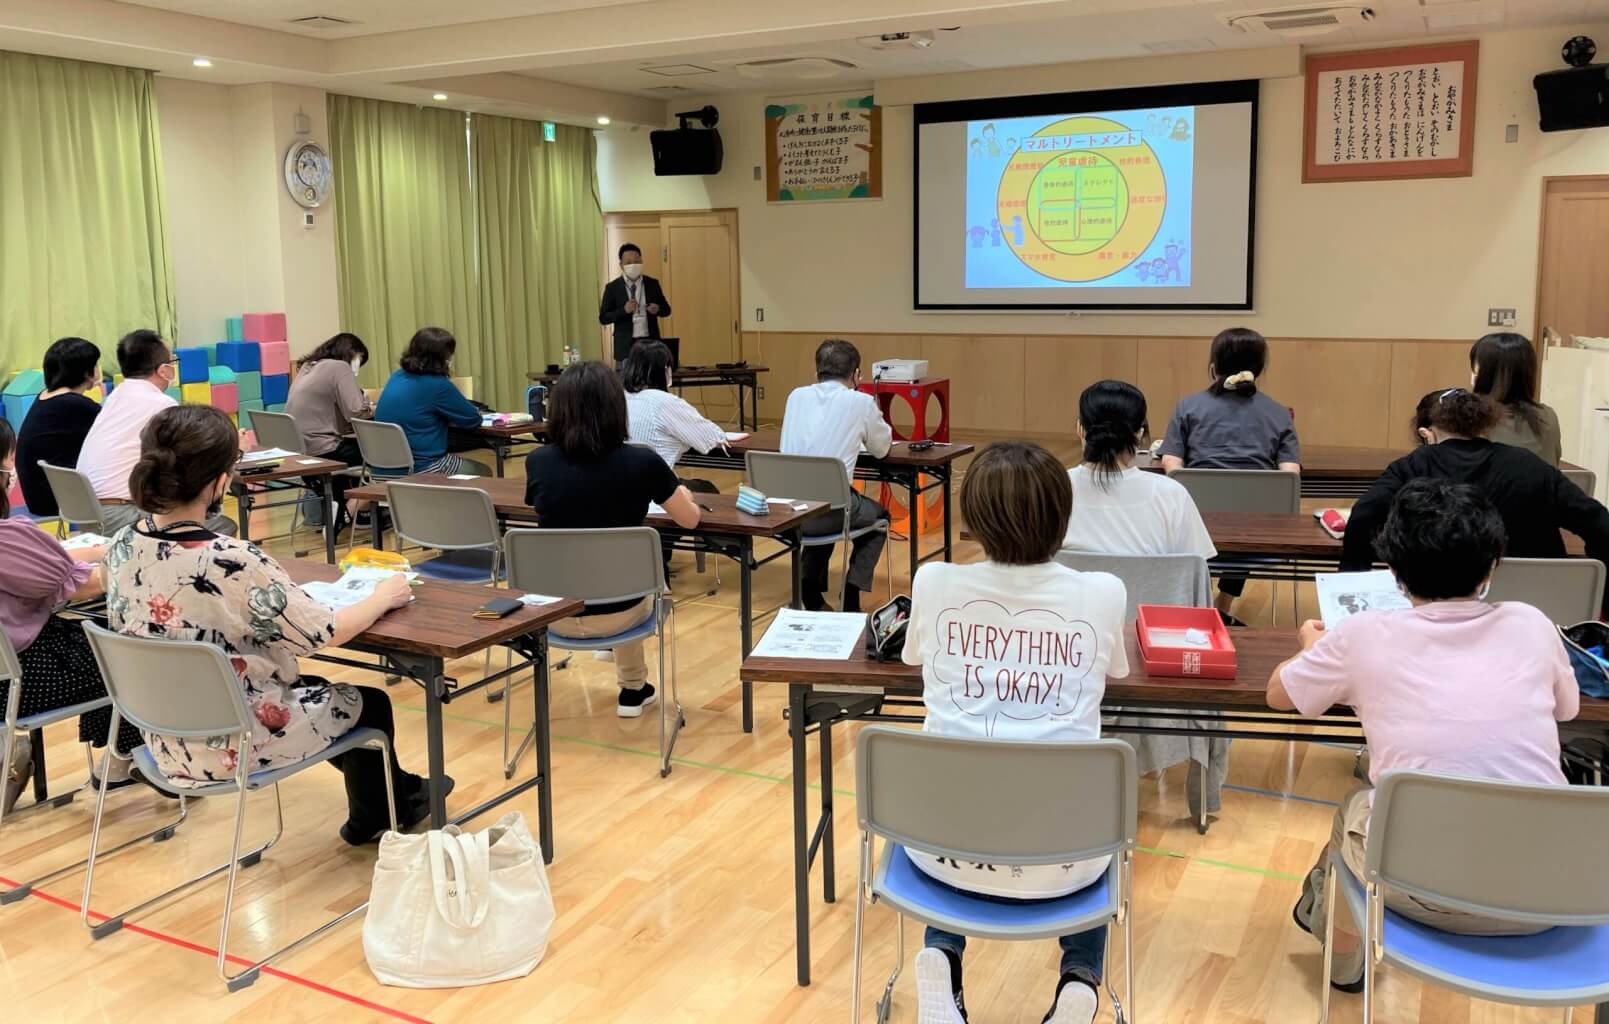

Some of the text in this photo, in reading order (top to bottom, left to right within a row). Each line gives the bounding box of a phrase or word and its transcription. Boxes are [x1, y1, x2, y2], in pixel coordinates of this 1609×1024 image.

[1024, 132, 1137, 150] マルトリートメント
[947, 621, 1083, 668] EVERYTHING
[964, 664, 1063, 707] IS OKAY!
